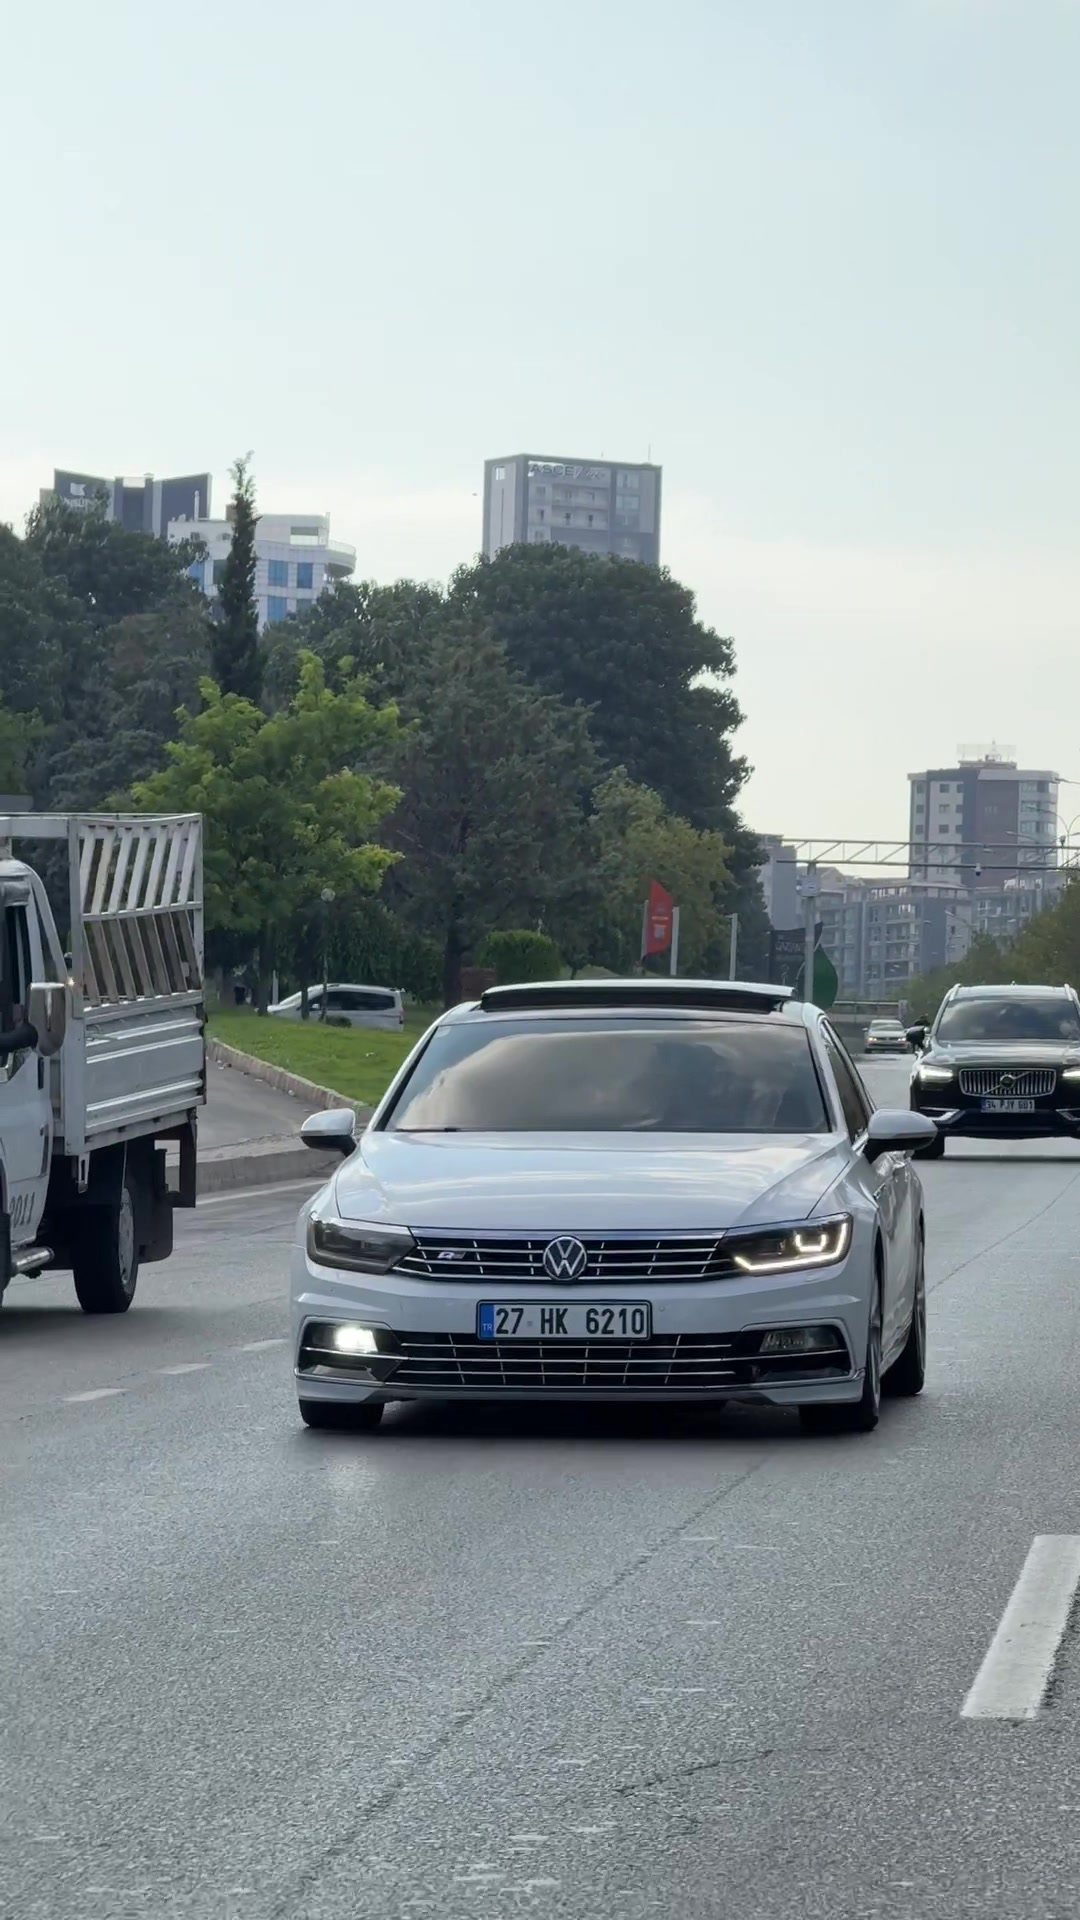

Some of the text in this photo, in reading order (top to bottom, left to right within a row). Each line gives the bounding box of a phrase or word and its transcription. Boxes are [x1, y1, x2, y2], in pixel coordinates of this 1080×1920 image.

[483, 1323, 493, 1331] TR
[496, 1308, 645, 1334] 27 HK 6210
